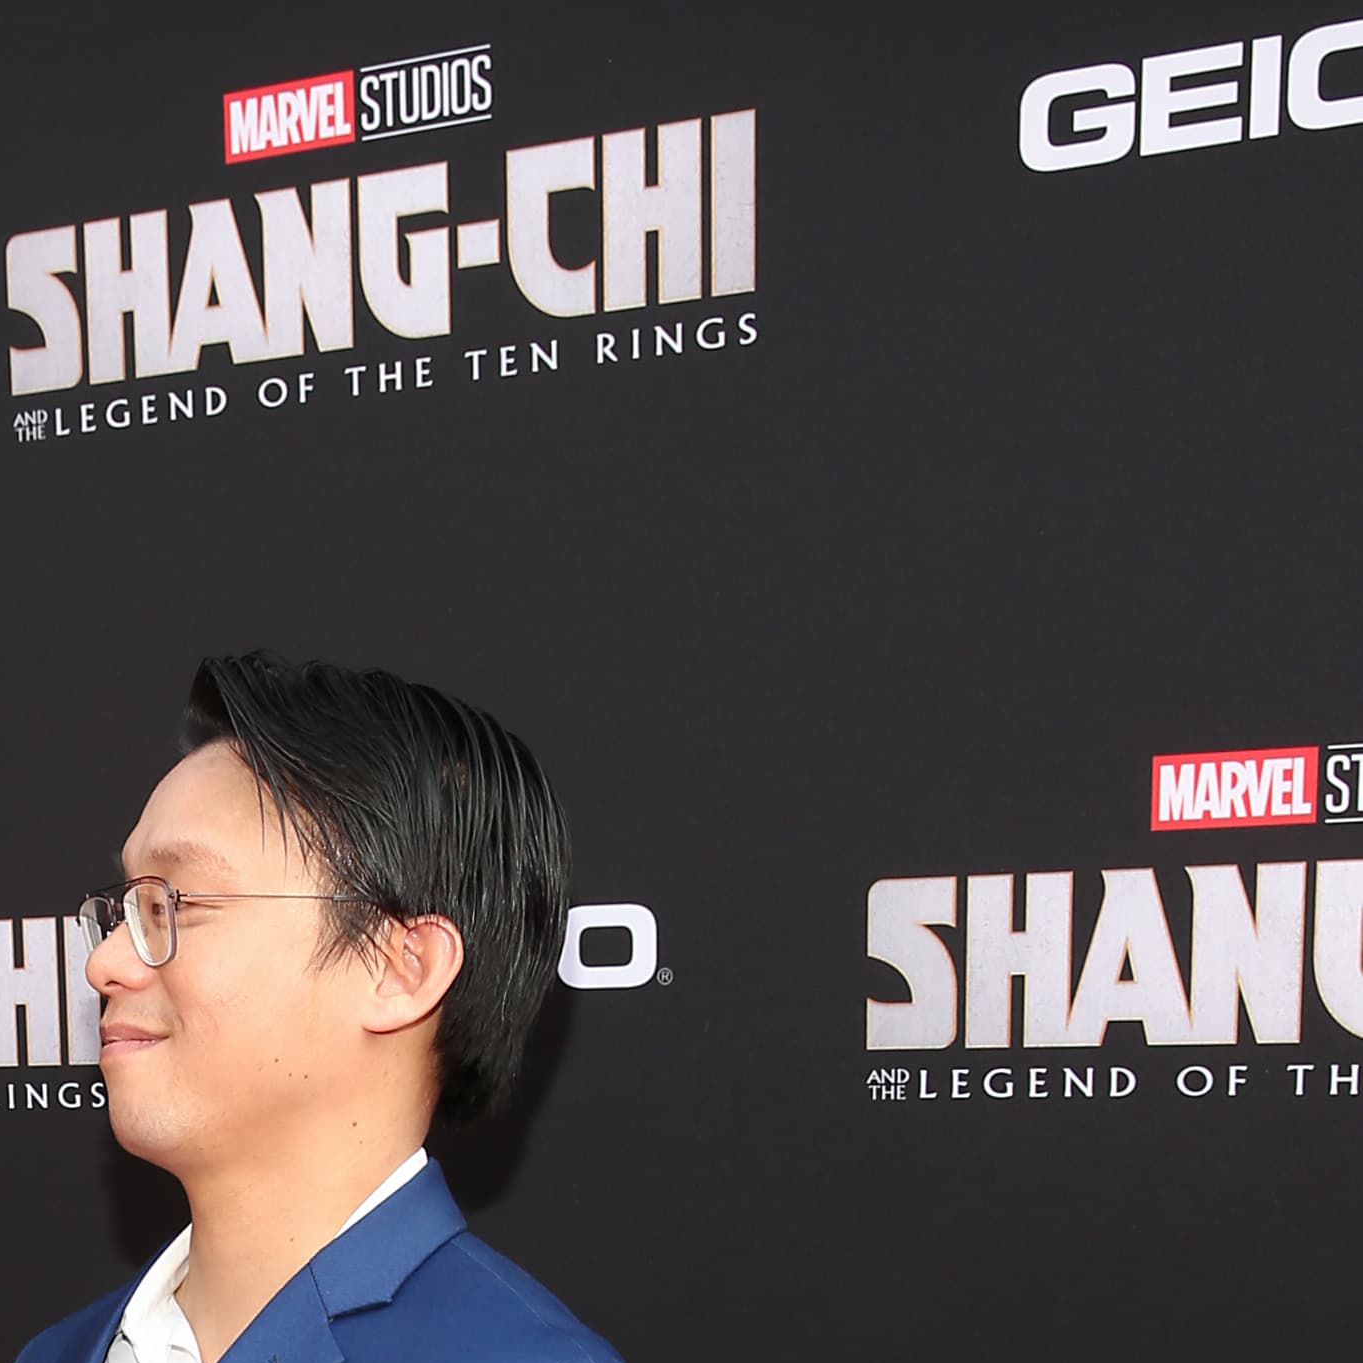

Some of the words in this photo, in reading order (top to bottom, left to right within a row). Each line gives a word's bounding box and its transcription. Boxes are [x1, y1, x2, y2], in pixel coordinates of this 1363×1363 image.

[229, 81, 351, 155] MARVEL
[360, 55, 491, 130] STUDIOS
[1020, 20, 1363, 171] GEIC
[6, 109, 755, 396] SHANG-CHI
[55, 387, 226, 435] LEGEND
[259, 373, 314, 407] OF
[345, 357, 433, 396] THE
[465, 340, 557, 380] TEN
[597, 313, 757, 363] RINGS
[13, 410, 49, 428] AND
[15, 425, 46, 442] THE
[1159, 757, 1312, 822] MARVEL
[866, 1068, 910, 1085] AND
[868, 1084, 907, 1101] THE
[920, 1067, 1136, 1098] LEGEND
[1177, 1066, 1247, 1096] OF
[1287, 1064, 1359, 1095] TH
